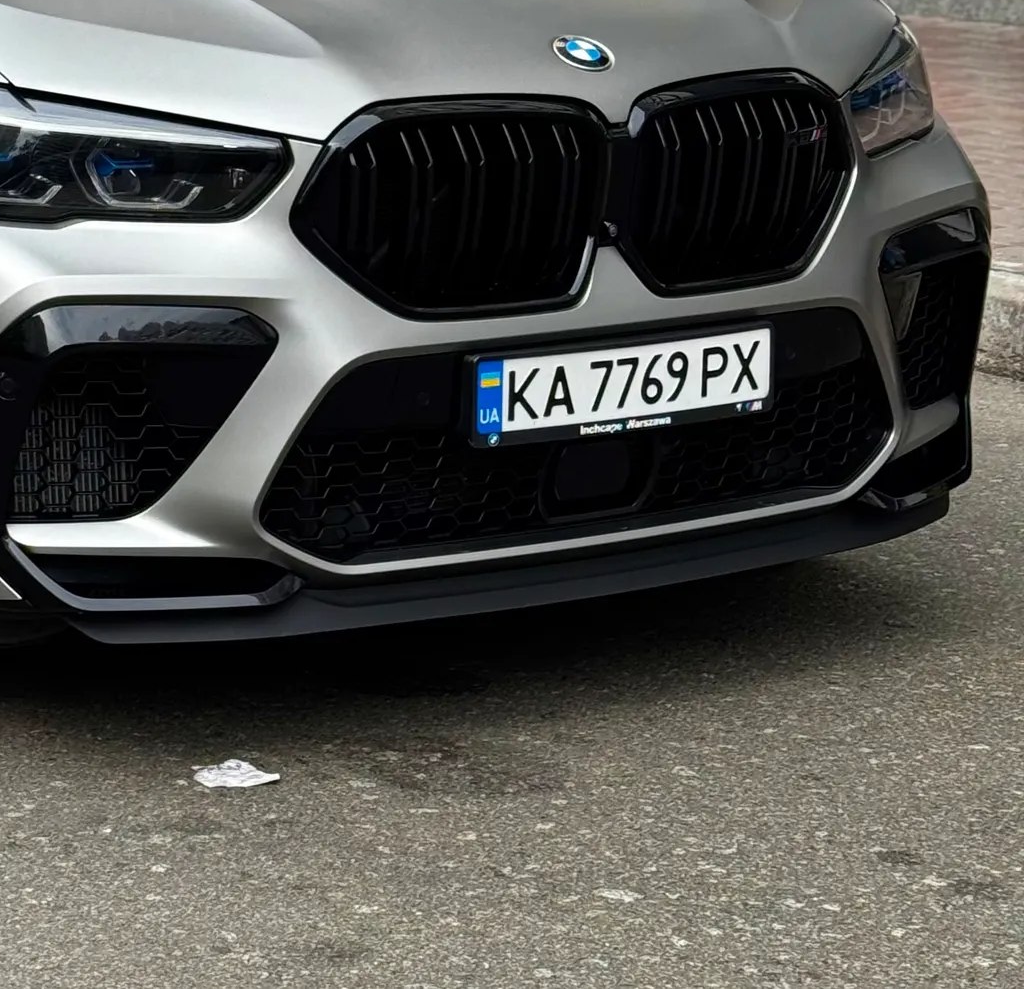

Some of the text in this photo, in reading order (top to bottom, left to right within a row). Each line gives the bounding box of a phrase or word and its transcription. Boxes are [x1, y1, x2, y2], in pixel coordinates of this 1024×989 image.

[507, 340, 761, 422] KA 7769 PX
[479, 407, 499, 424] UA
[579, 416, 672, 436] Inchcape Warszawa
